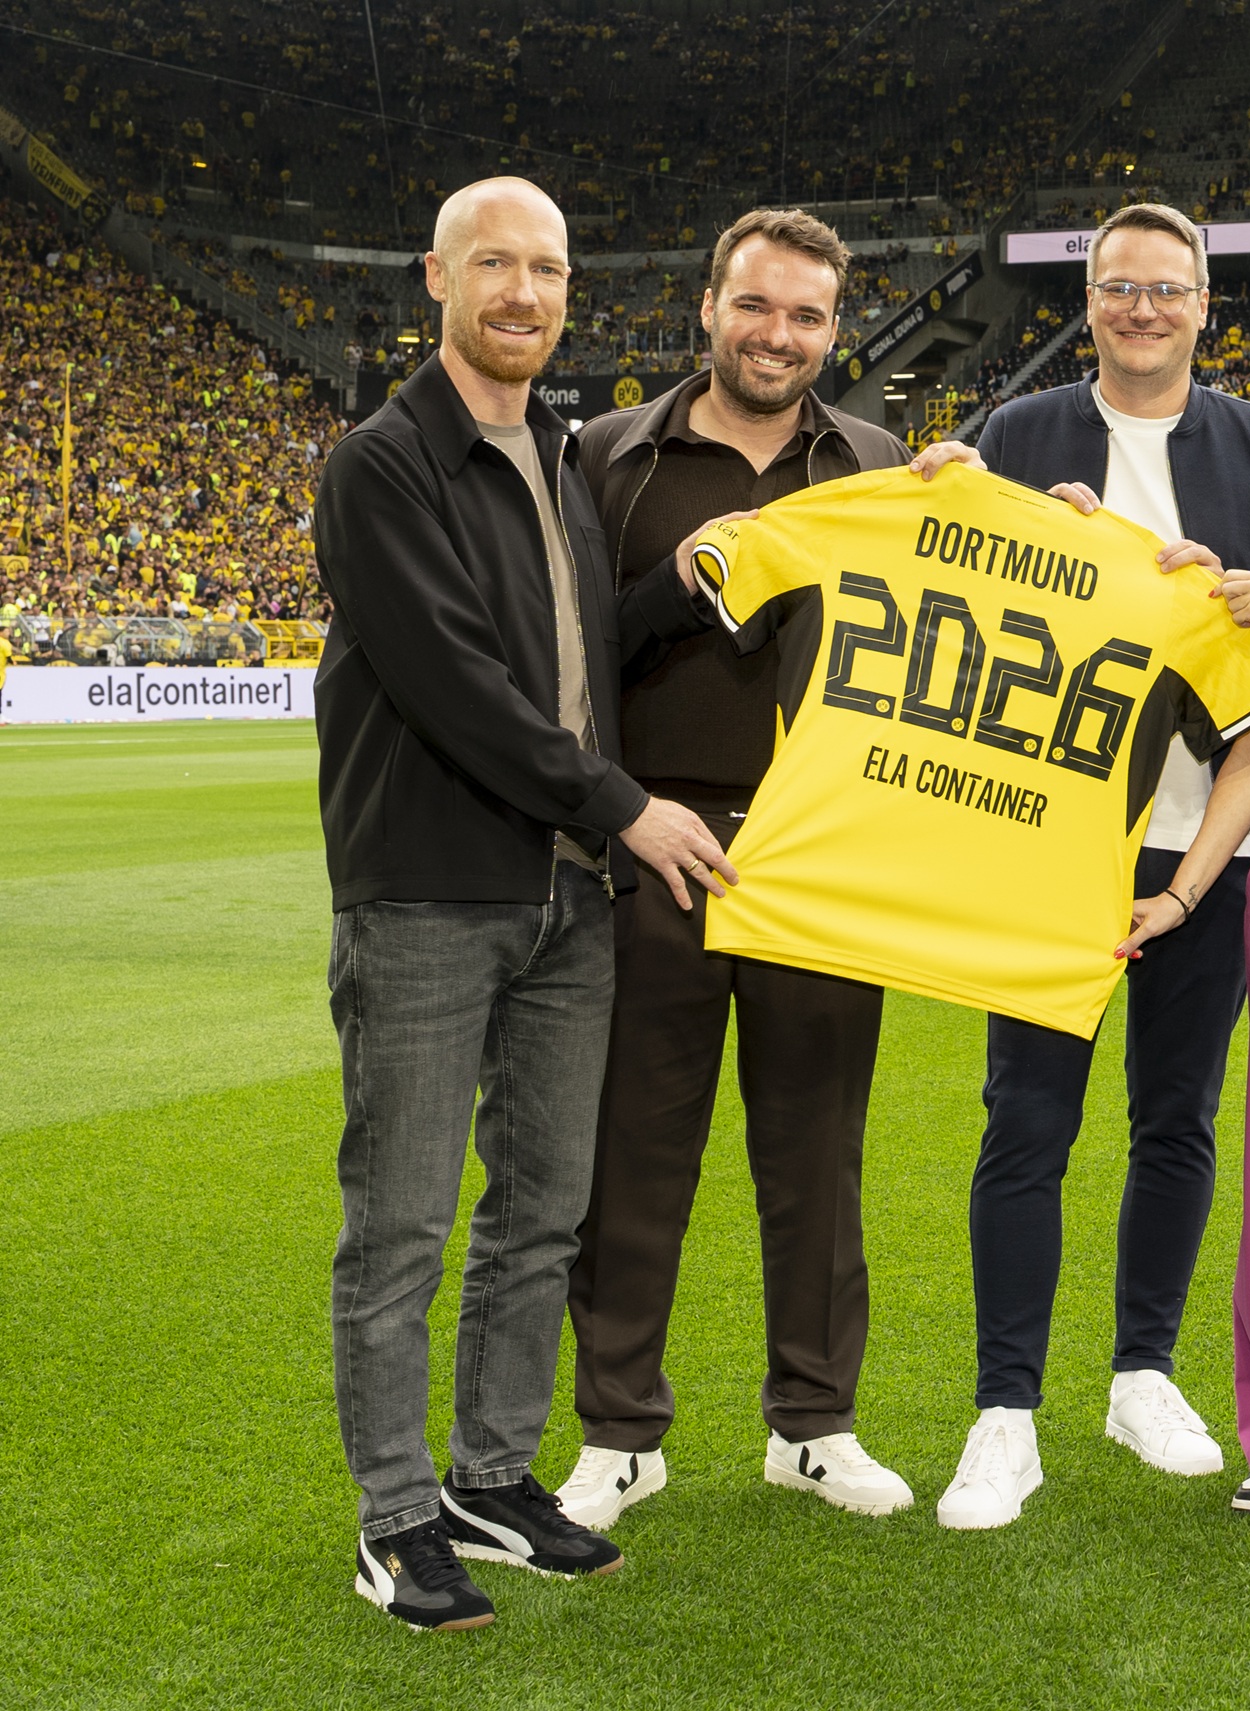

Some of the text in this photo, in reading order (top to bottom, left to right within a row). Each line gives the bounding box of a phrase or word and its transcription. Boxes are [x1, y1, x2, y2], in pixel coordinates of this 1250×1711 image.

[539, 386, 580, 405] fone
[914, 515, 1099, 601] DORTMUND
[87, 672, 293, 714] ela[container]
[821, 570, 1153, 782] 2026
[863, 745, 1048, 828] ELA CONTAINER
